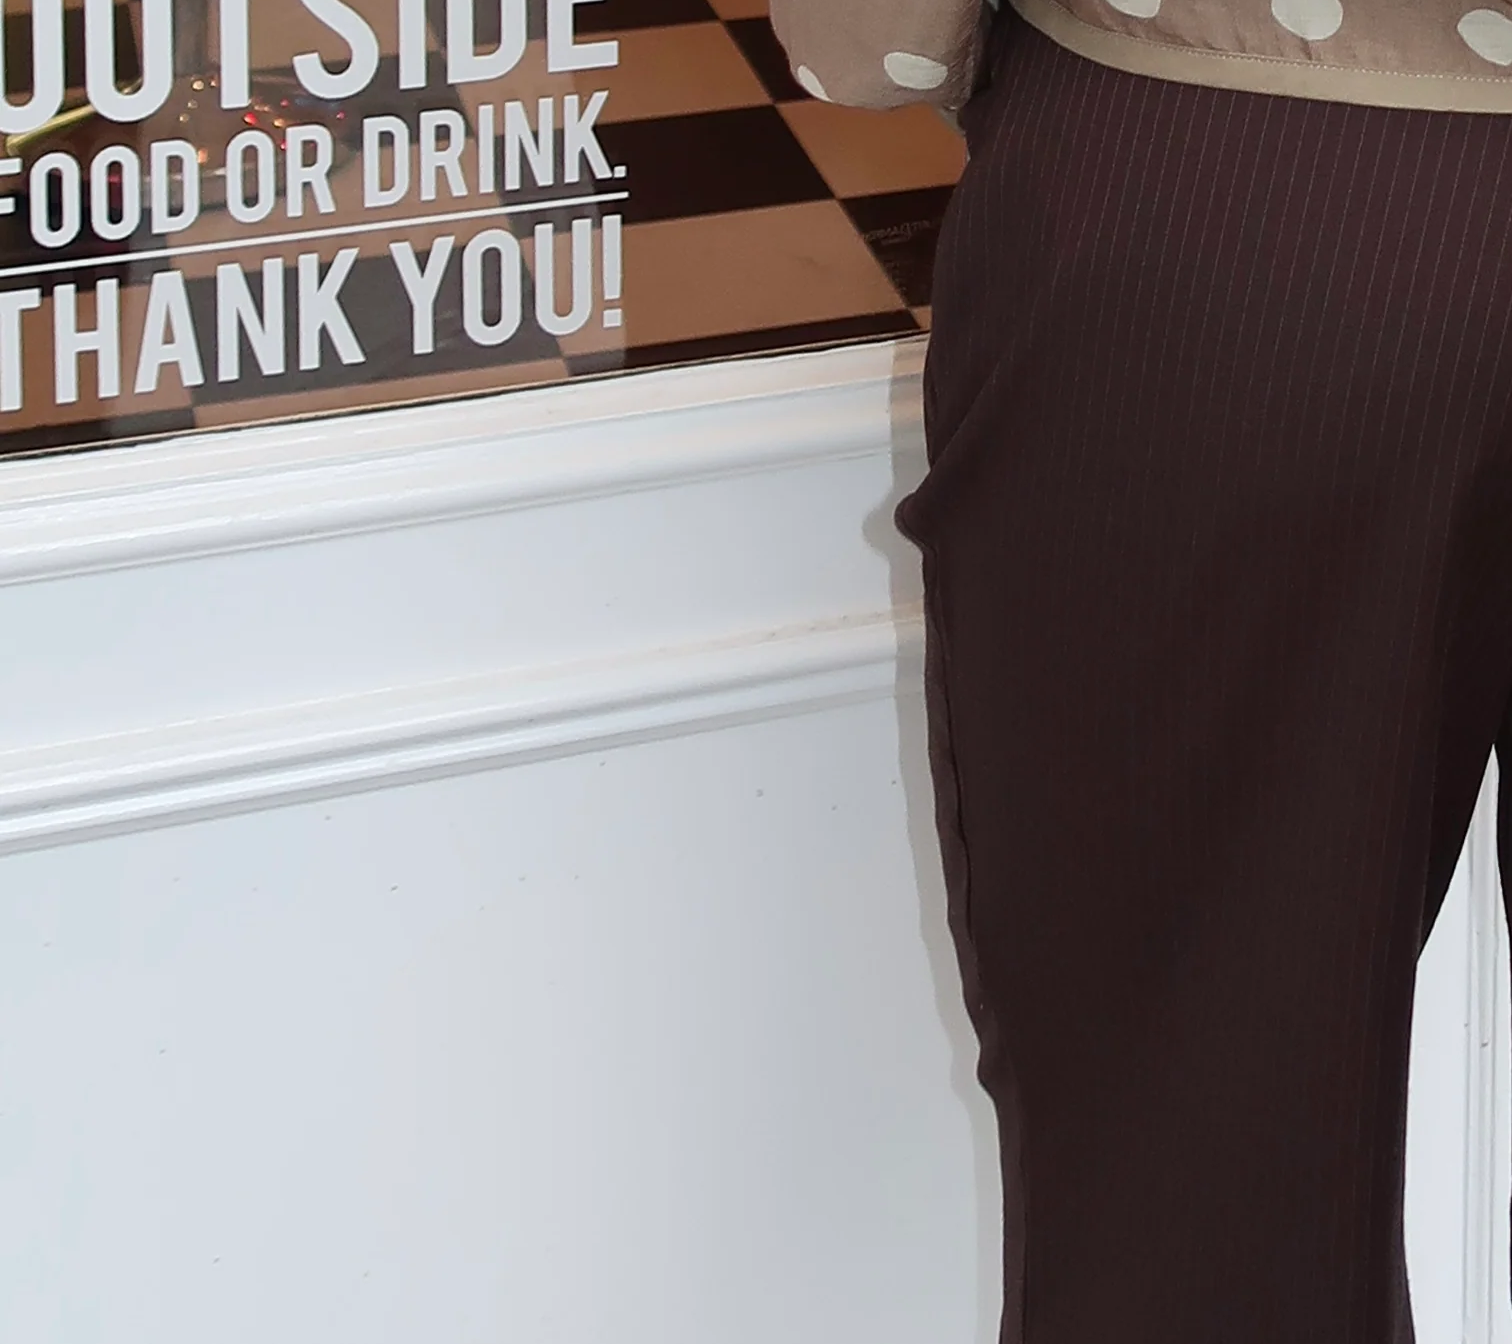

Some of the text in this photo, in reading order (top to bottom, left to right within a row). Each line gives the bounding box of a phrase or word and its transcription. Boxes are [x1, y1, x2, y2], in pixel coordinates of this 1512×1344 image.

[224, 123, 337, 224] OR
[363, 90, 627, 209] DRINK.
[0, 214, 623, 412] THANK YOU!
